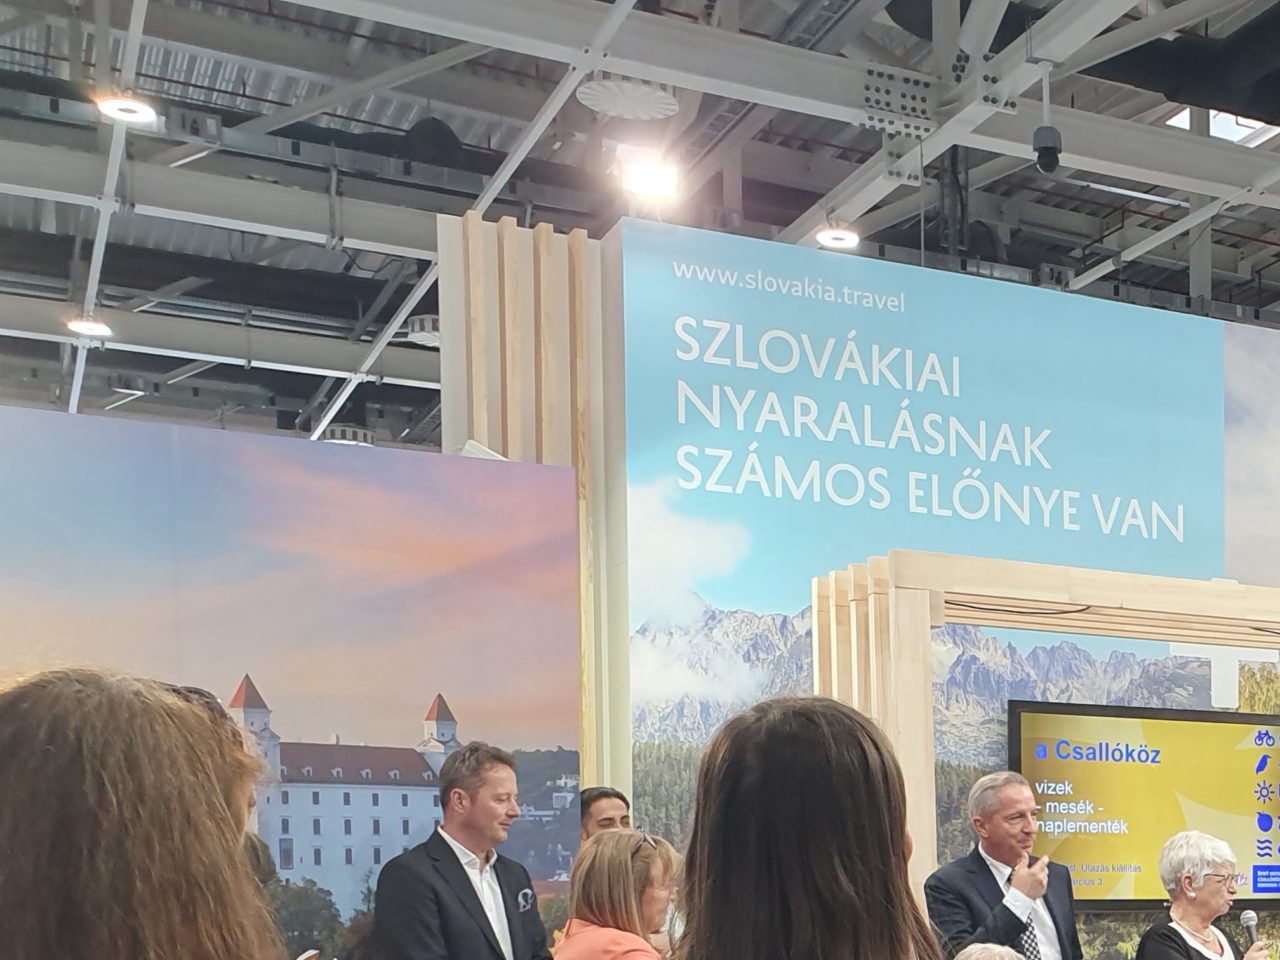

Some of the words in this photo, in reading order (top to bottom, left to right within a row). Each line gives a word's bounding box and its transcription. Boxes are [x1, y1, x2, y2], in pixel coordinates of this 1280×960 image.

[673, 261, 905, 313] www.slovakia.travel
[674, 316, 960, 397] SZLOVÁKIAI
[676, 380, 1052, 470] NYARALÁSNAK
[676, 442, 891, 510] SZÁMOS
[909, 467, 1080, 532] ELŐNYE
[1092, 493, 1184, 542] VAN
[1035, 743, 1048, 760] a
[1055, 739, 1161, 764] Csallóköz
[1035, 780, 1073, 795] vizek
[1046, 800, 1094, 814] mesék
[1036, 818, 1128, 836] naplementék
